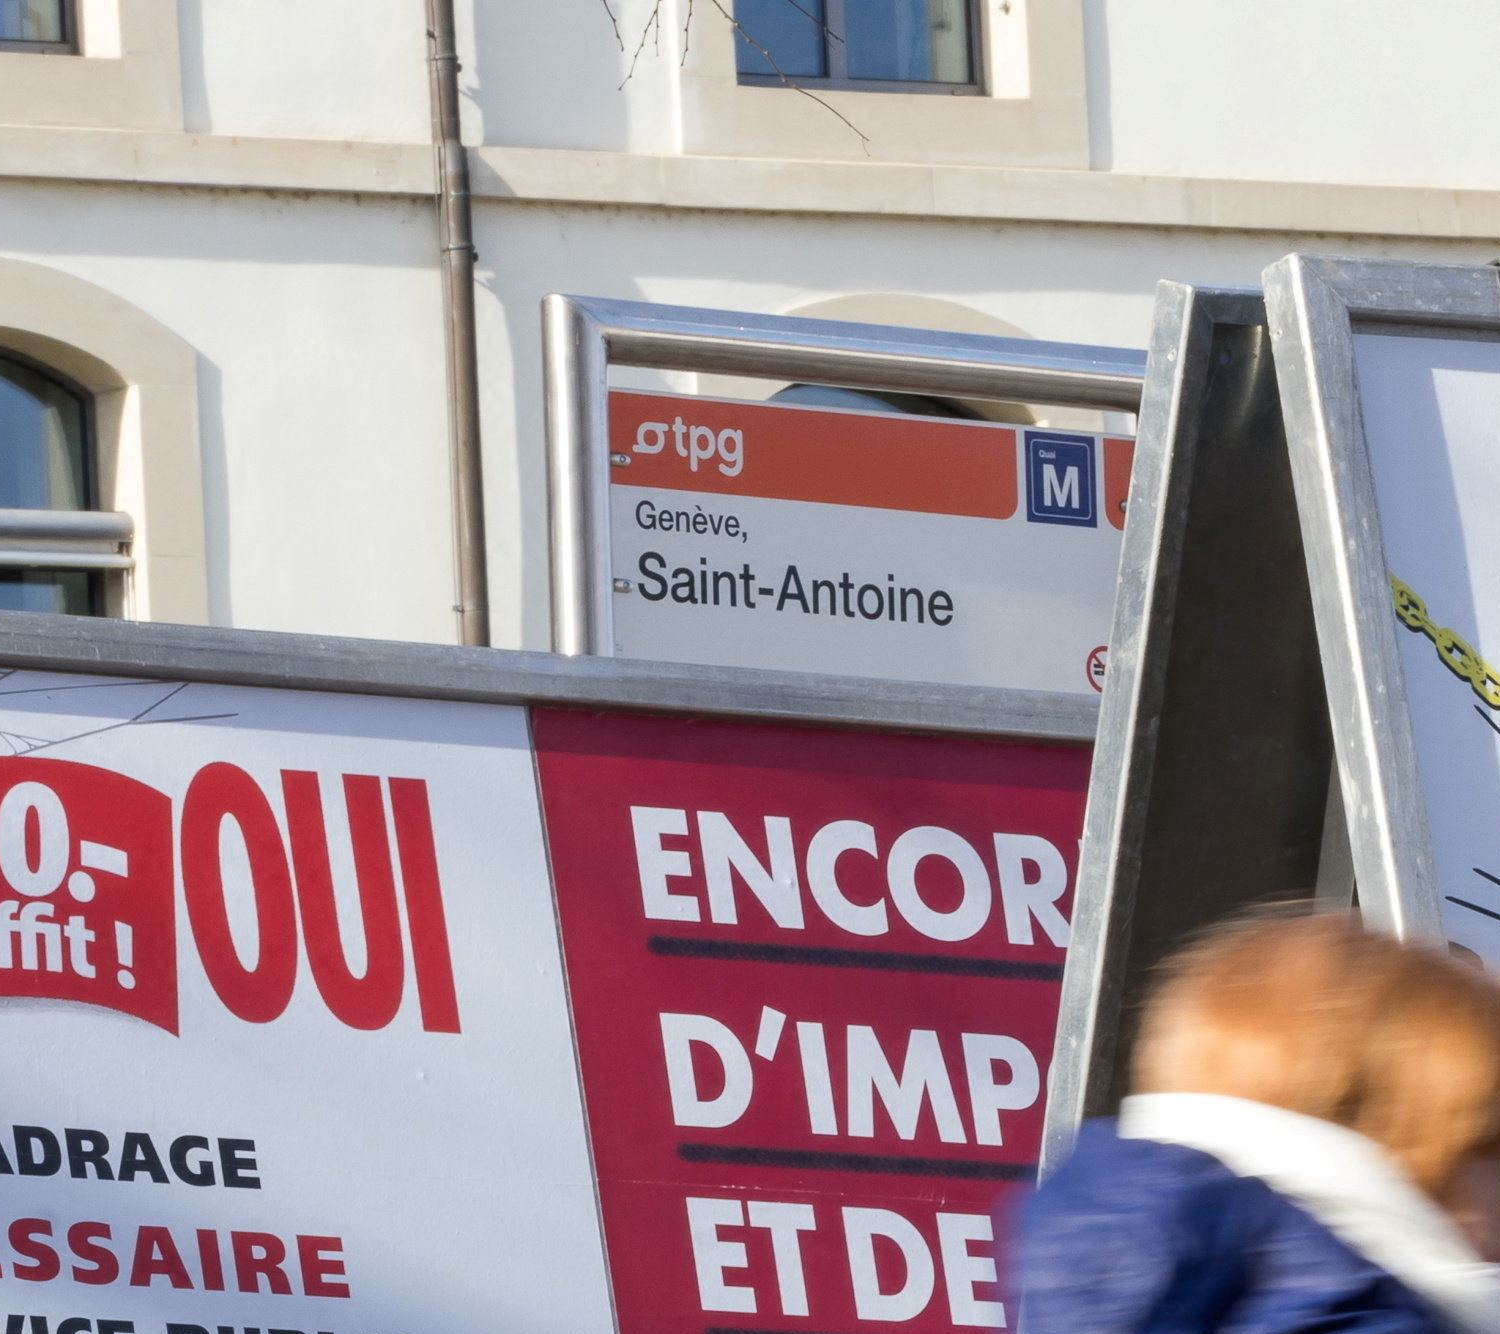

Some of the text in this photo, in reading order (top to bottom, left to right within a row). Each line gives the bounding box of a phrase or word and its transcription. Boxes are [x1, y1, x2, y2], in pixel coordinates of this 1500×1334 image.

[1038, 449, 1056, 459] Quai
[1043, 463, 1080, 509] M
[634, 500, 749, 543] Genève,
[637, 551, 954, 626] Saint-Antoine
[180, 760, 462, 1034] OUI
[630, 805, 1084, 949] ENCOR
[114, 919, 137, 990] !
[659, 1005, 1053, 1147] D'IMP
[686, 1196, 816, 1316] ET
